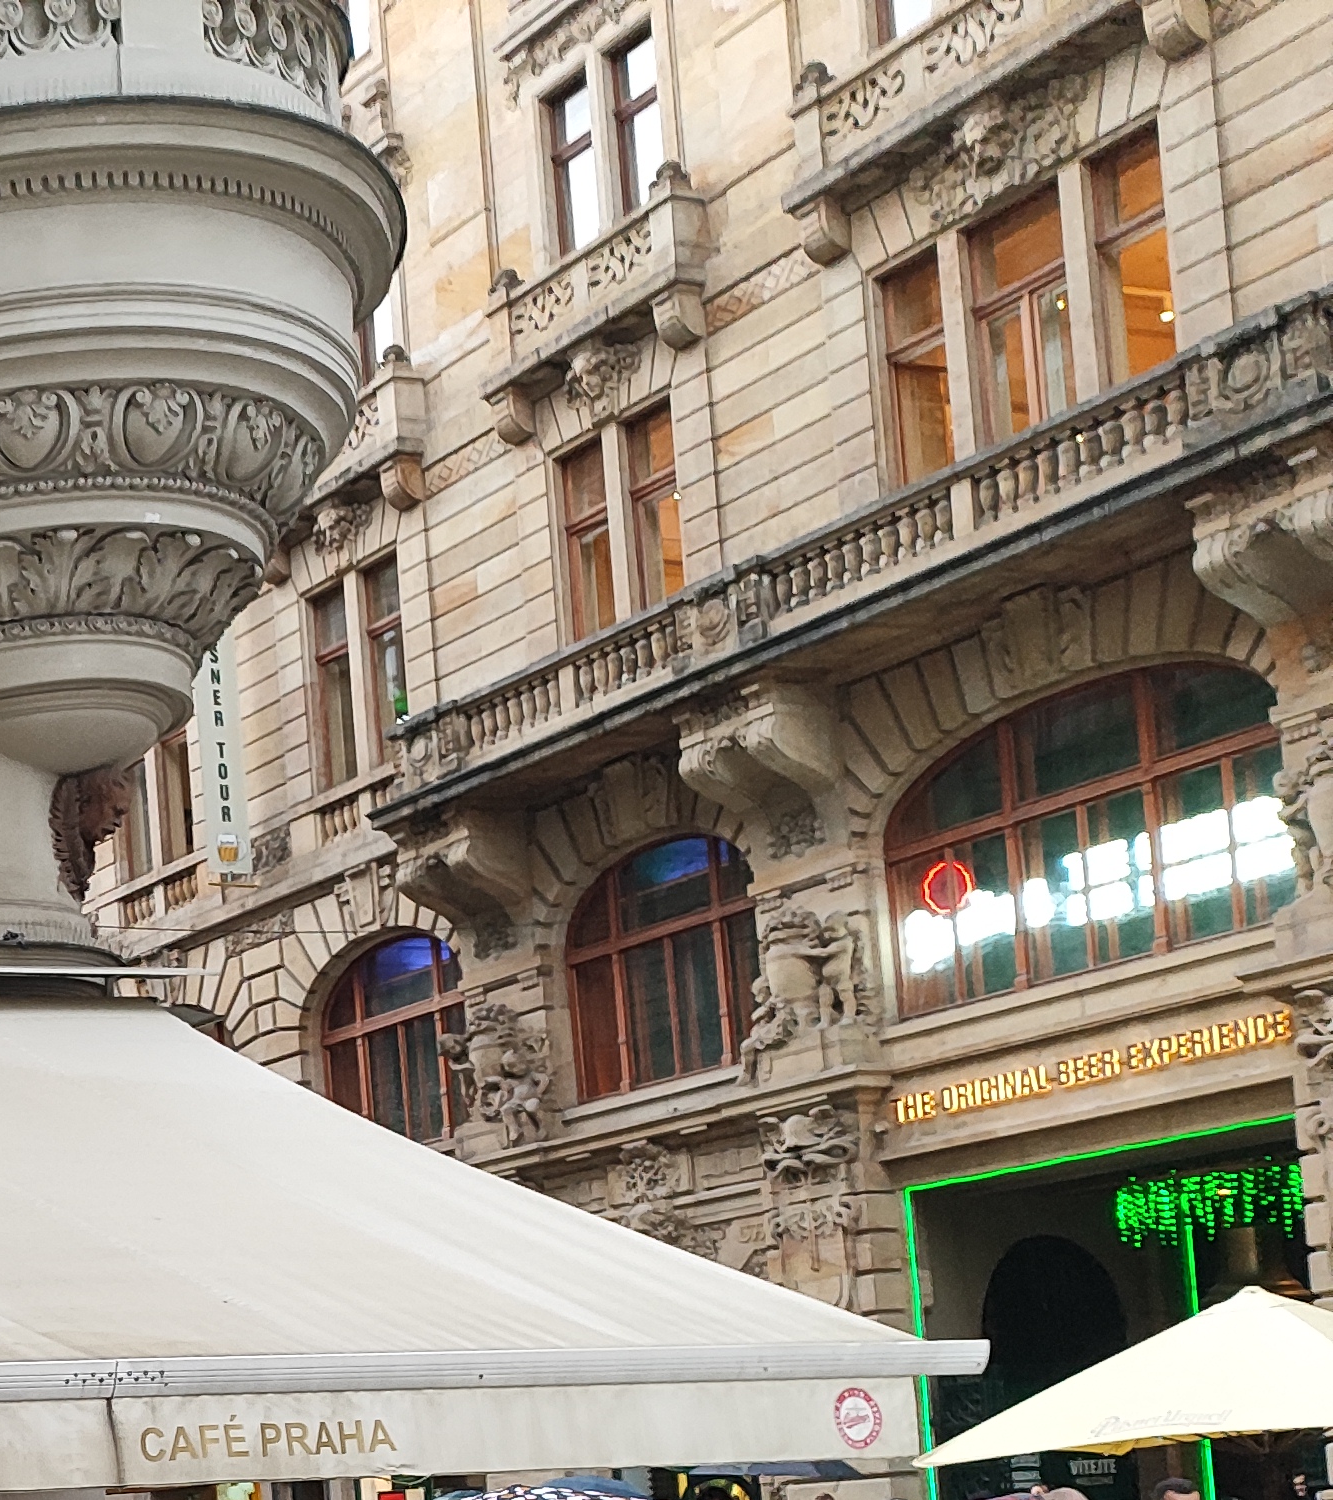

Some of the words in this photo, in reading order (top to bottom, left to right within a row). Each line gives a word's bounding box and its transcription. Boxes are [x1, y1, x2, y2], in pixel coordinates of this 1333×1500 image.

[216, 742, 231, 822] TOUR
[895, 1089, 936, 1123] THE
[941, 1065, 1052, 1113] ORIGINAL
[1057, 1049, 1121, 1086] BEER
[1127, 1008, 1292, 1070] EXPERIENCE
[140, 1415, 250, 1462] CAFÉ
[260, 1419, 397, 1457] PRAHA
